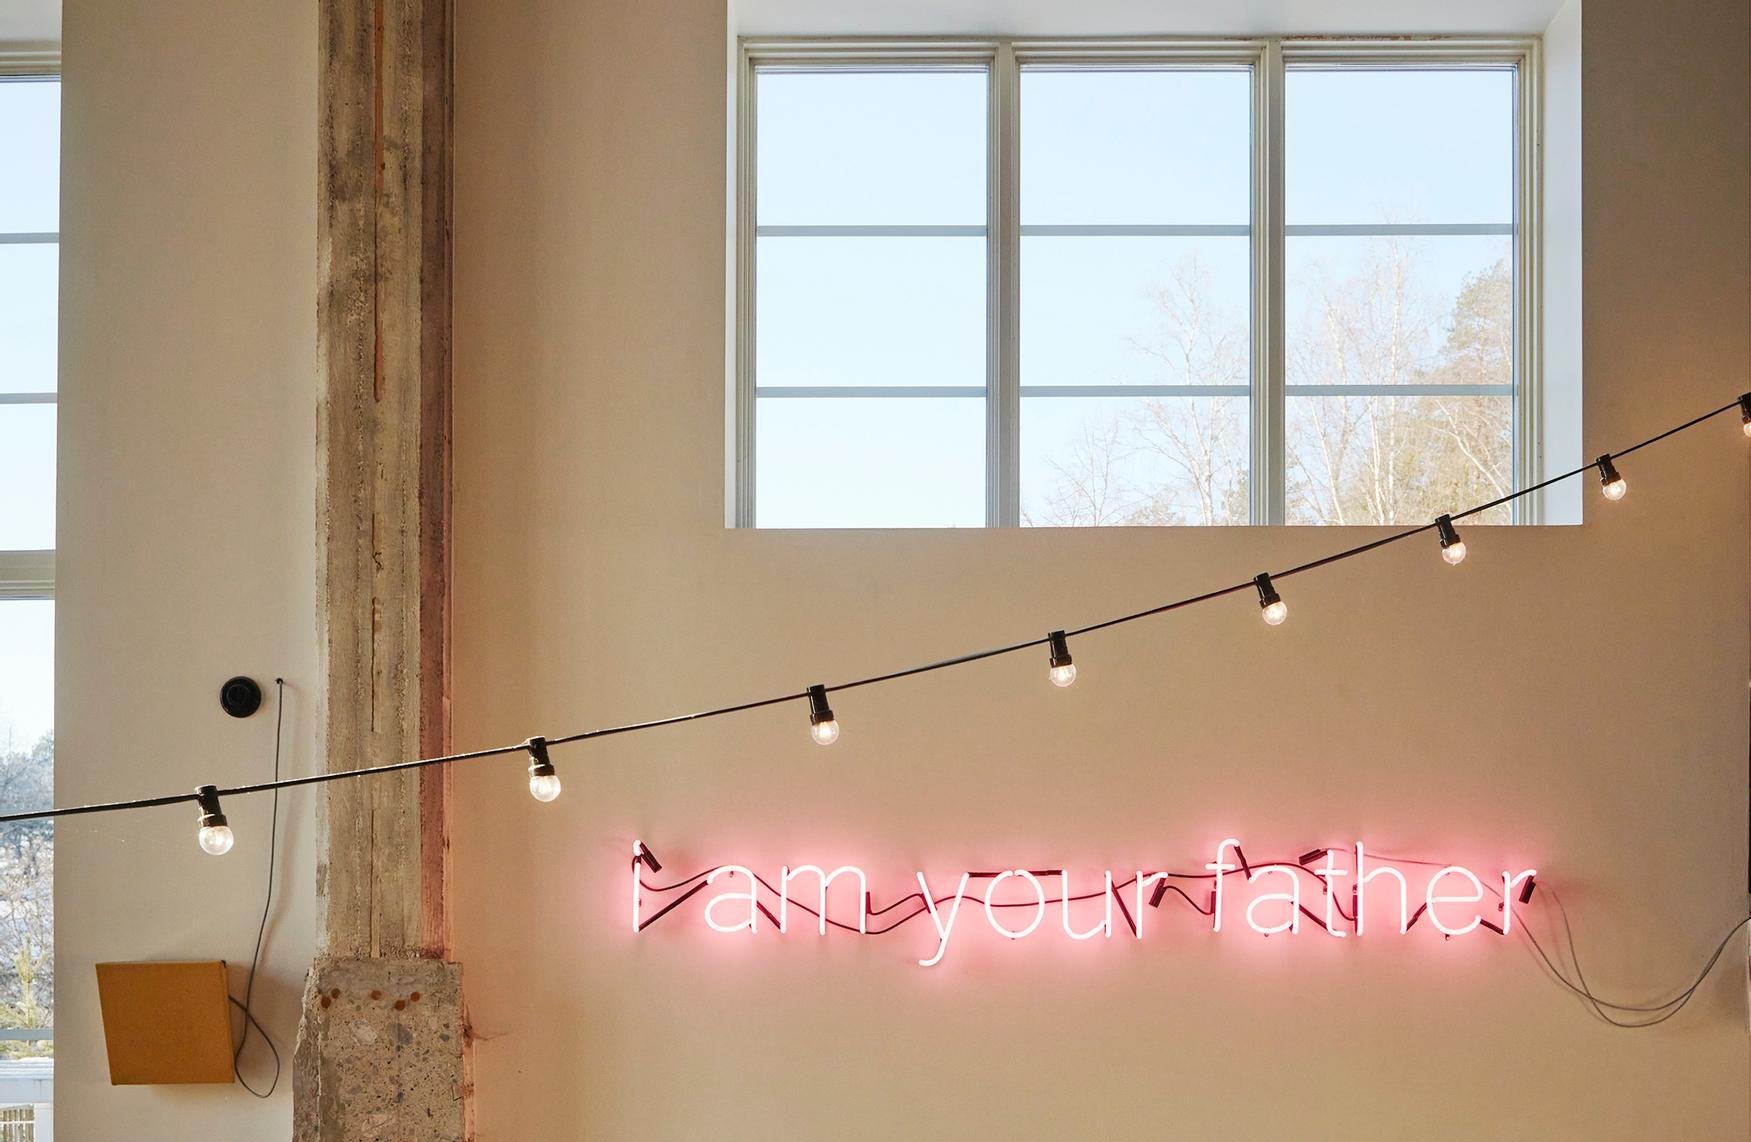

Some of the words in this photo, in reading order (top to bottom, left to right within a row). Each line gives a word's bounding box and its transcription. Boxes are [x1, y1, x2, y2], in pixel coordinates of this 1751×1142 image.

[630, 840, 645, 933] i
[703, 863, 869, 935] am
[914, 867, 1168, 967] your
[1205, 836, 1538, 939] father
